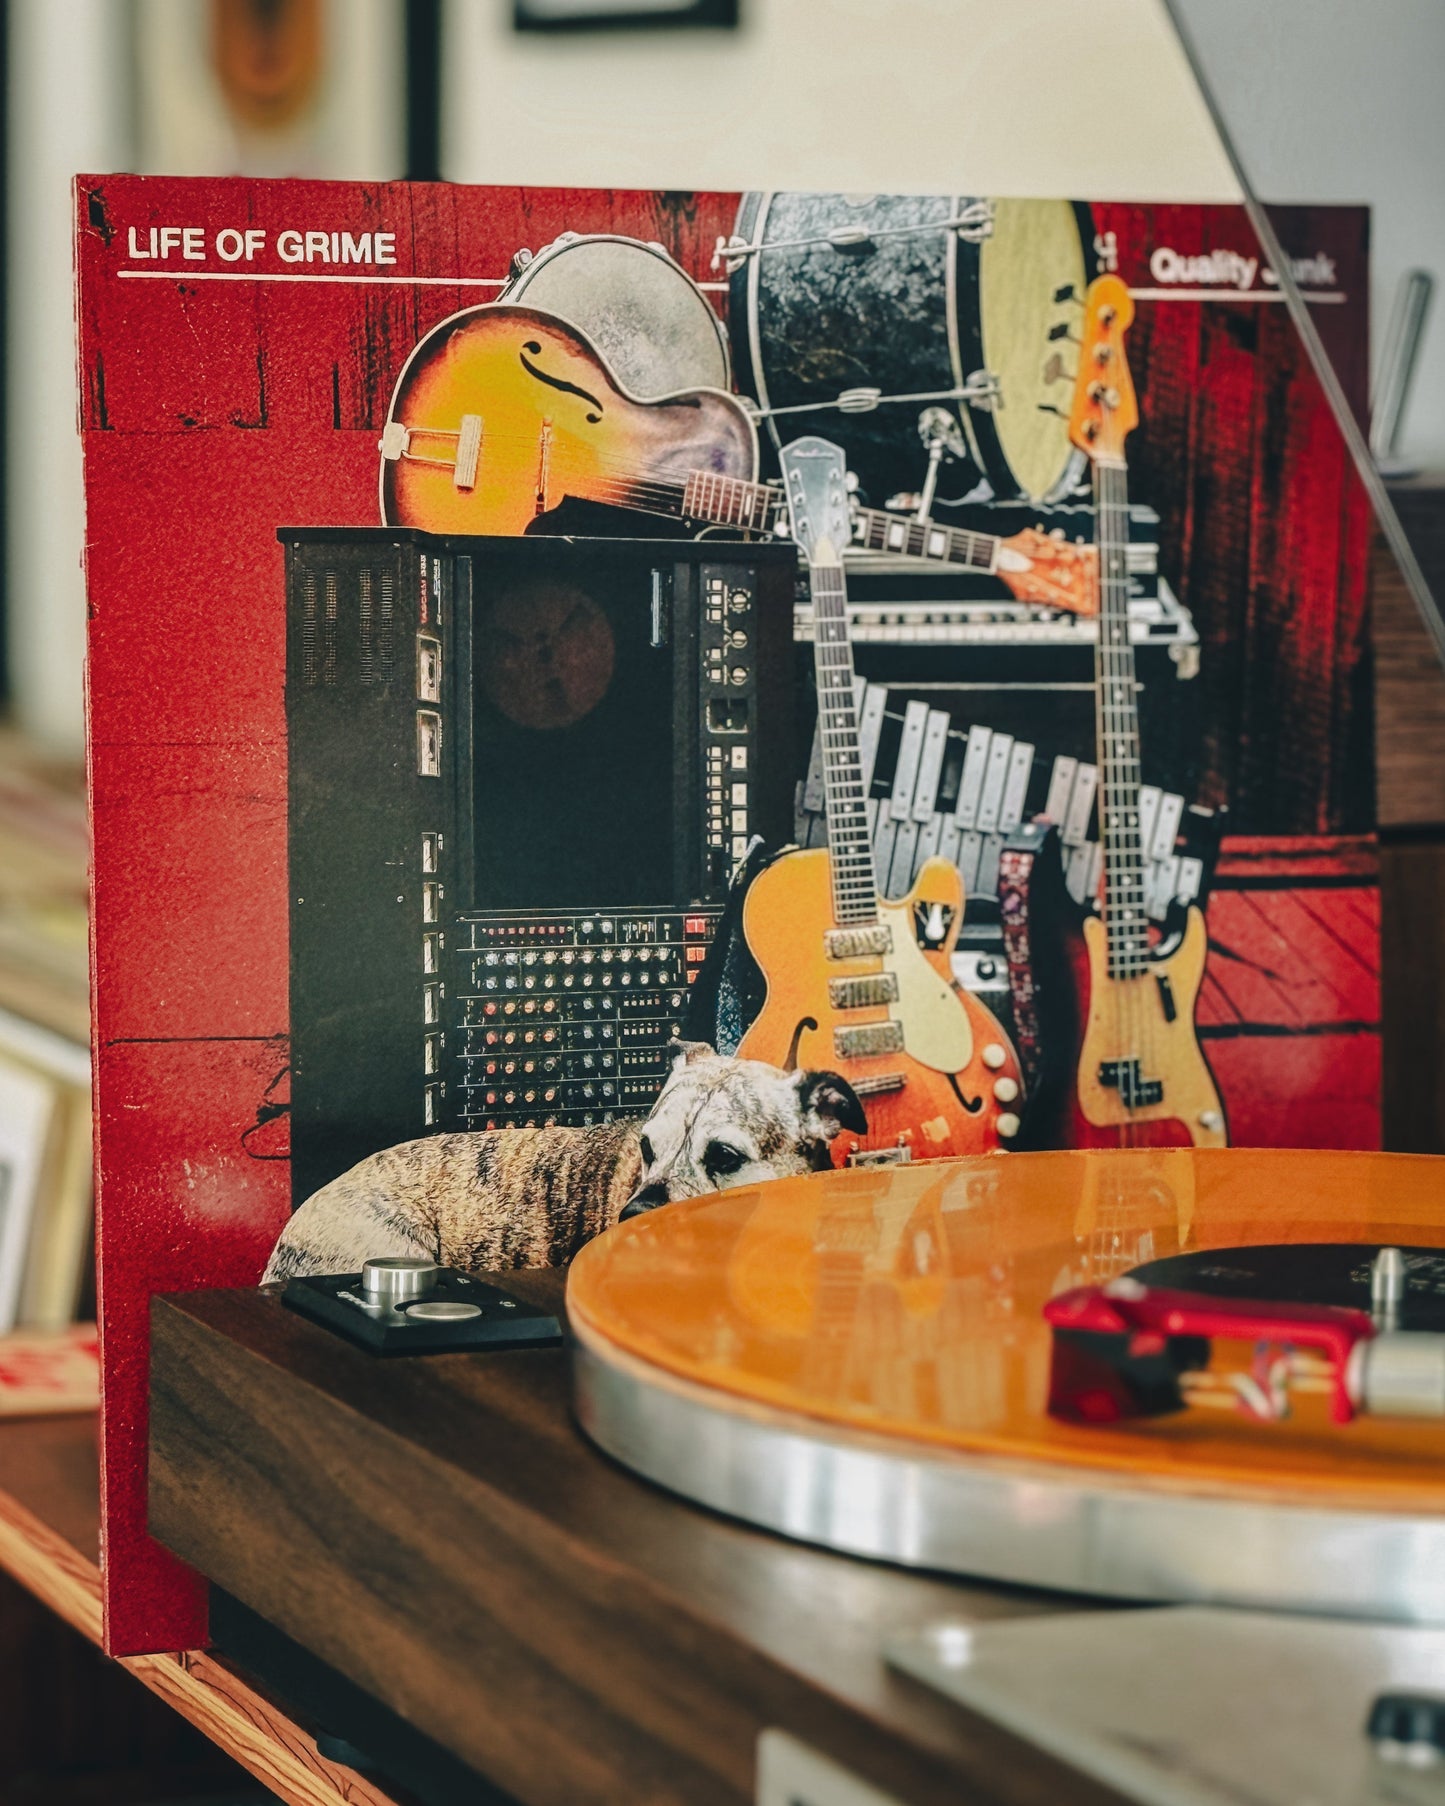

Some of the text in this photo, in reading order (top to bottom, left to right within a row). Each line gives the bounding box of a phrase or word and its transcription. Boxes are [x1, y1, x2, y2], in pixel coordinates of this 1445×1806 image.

[128, 226, 398, 264] LIFE OF GRIME
[1151, 248, 1258, 290] Quality
